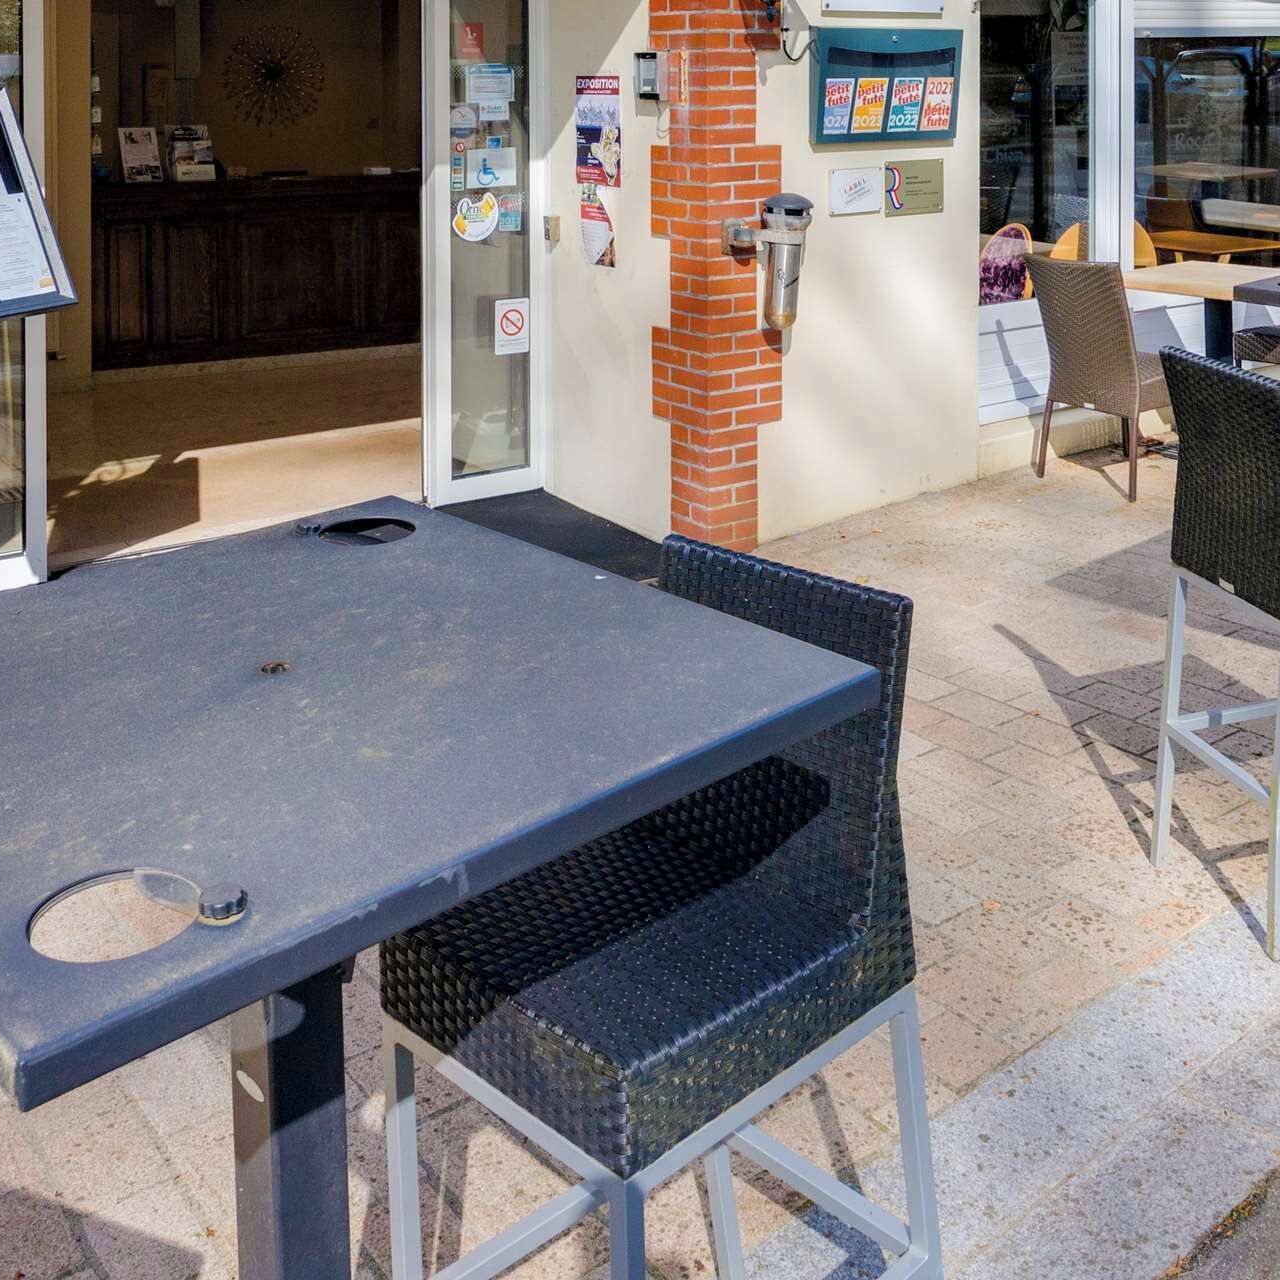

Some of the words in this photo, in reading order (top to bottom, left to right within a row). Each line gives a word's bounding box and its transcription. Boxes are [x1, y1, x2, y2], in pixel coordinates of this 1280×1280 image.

[576, 78, 619, 89] EXPOSITION
[857, 83, 885, 100] petit
[894, 82, 921, 99] petit
[928, 81, 953, 96] 2021
[923, 102, 951, 119] petit
[889, 114, 918, 127] 2022
